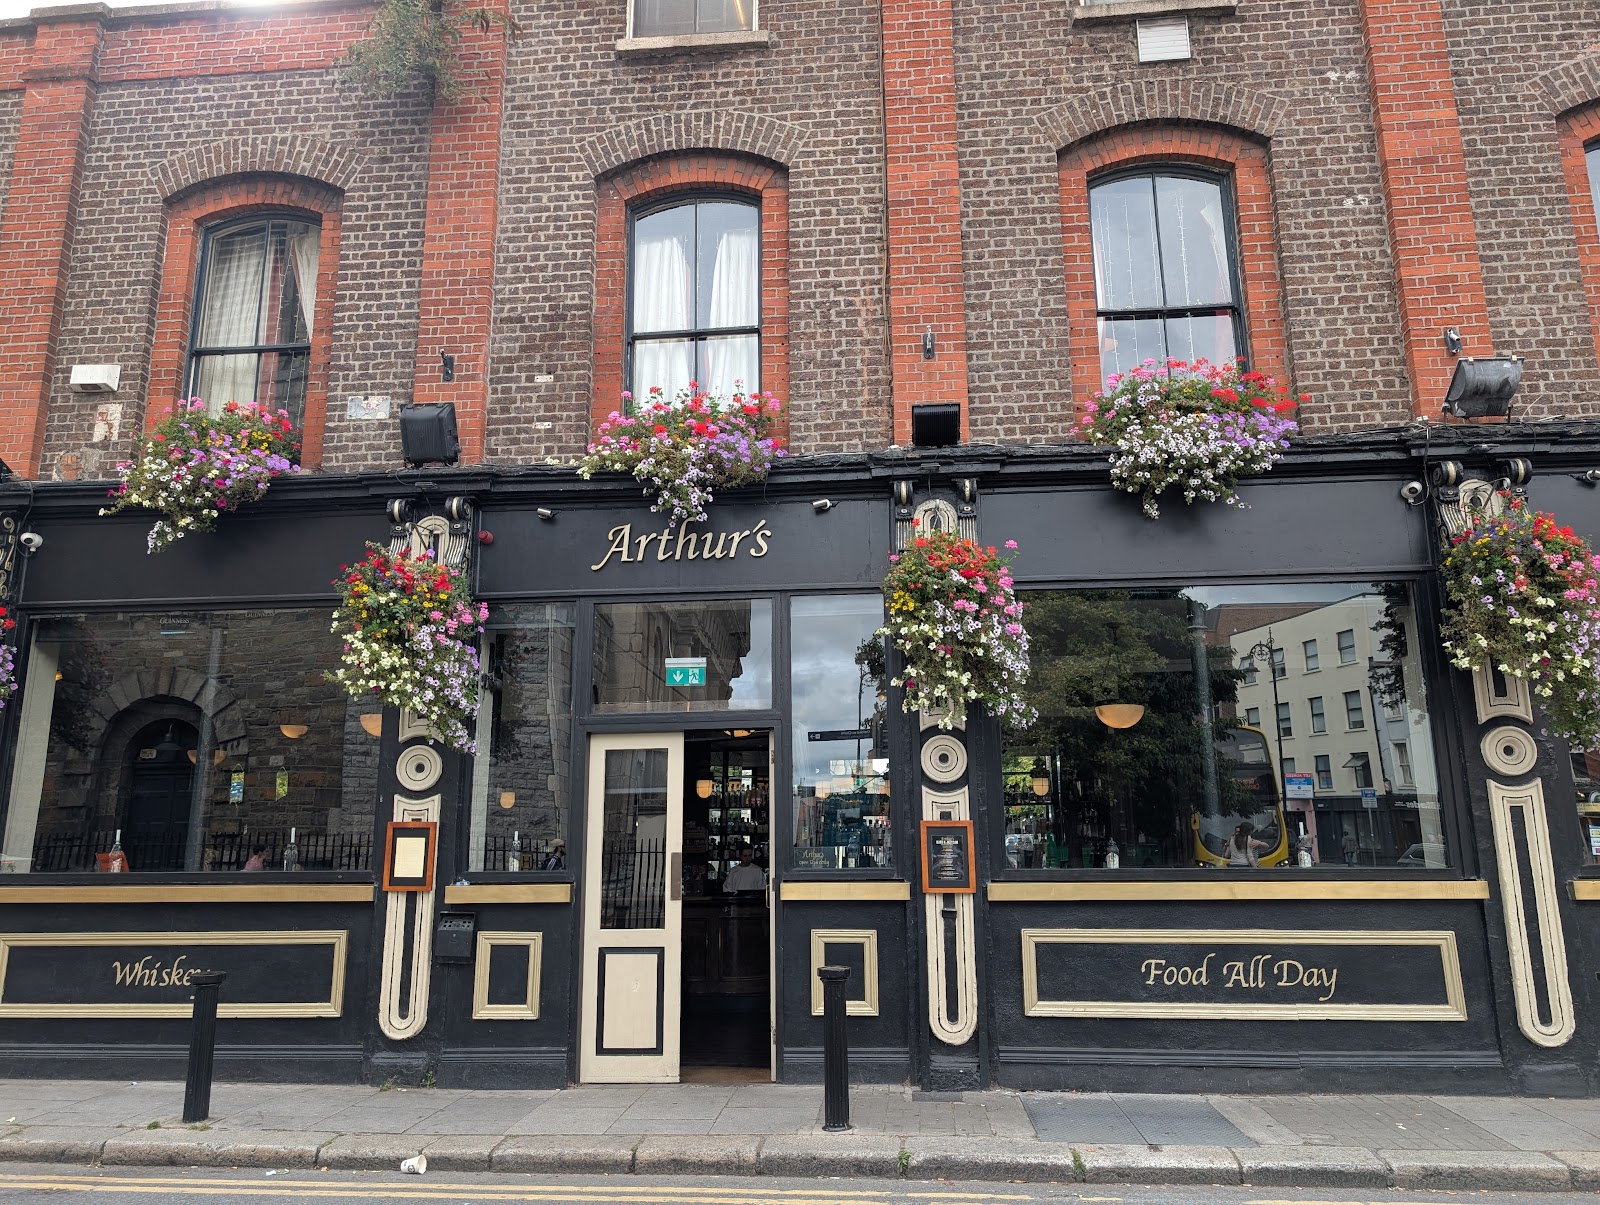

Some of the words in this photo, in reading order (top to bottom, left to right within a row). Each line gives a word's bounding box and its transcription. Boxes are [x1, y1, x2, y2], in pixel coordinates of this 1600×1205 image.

[591, 517, 772, 571] Arthur's
[112, 955, 210, 999] Whiske
[1141, 952, 1216, 986] Food
[1223, 954, 1272, 988] All
[1273, 959, 1338, 1001] Day
